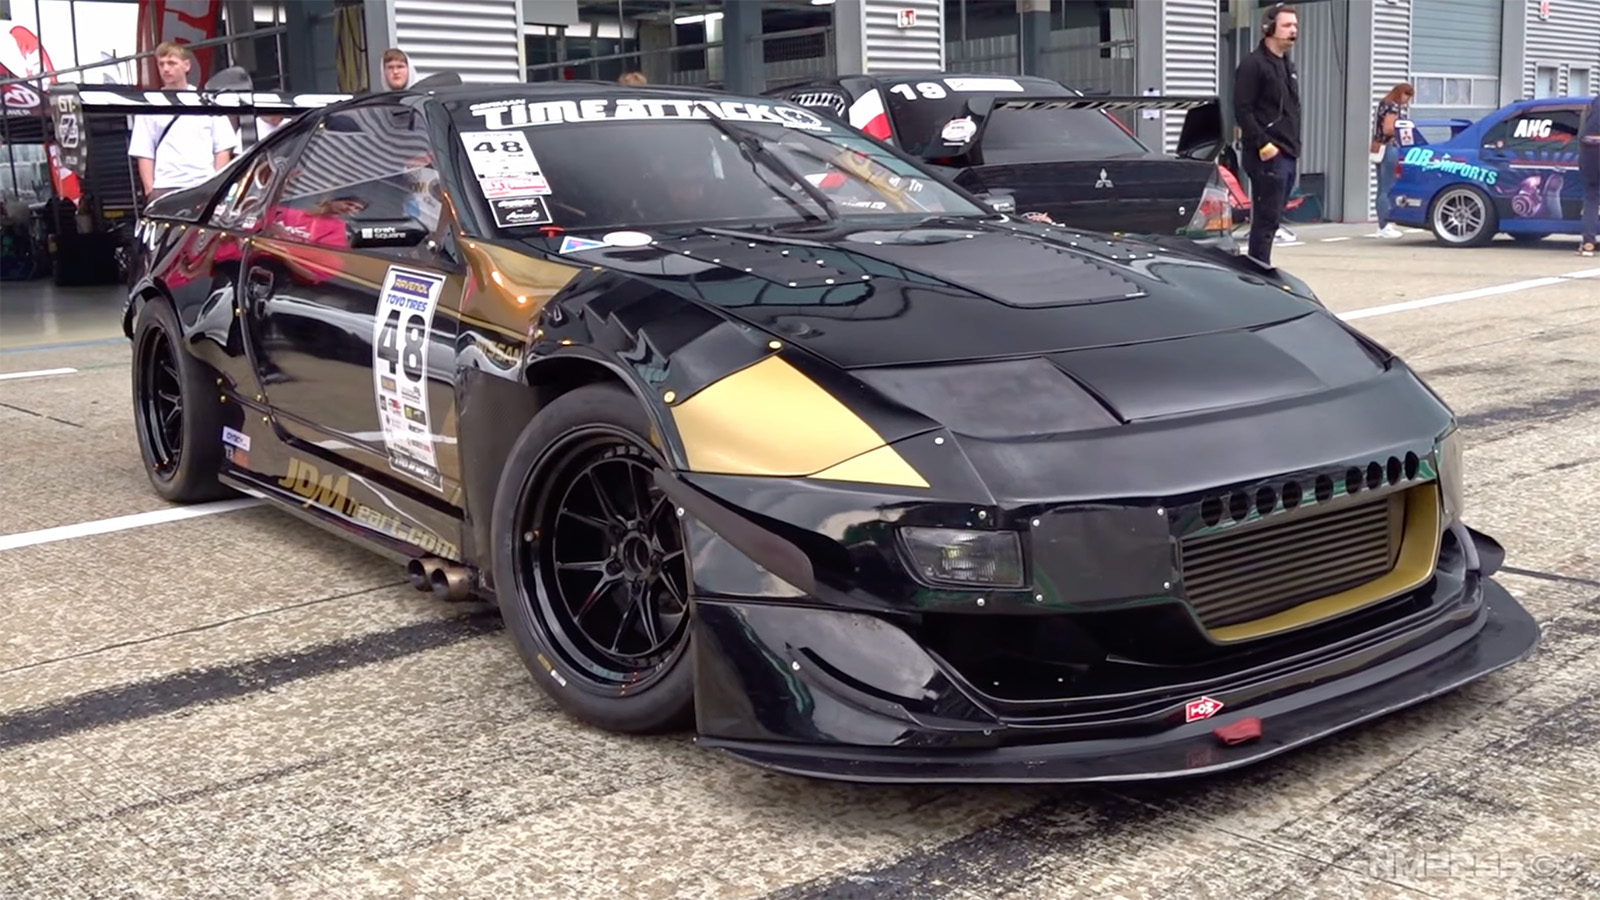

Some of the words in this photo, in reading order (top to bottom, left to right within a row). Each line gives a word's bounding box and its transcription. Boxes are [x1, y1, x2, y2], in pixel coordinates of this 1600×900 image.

[889, 82, 947, 100] 19
[1513, 119, 1553, 138] AHG
[473, 141, 524, 153] 48
[374, 232, 407, 240] square
[395, 278, 428, 294] RAVENOL
[386, 293, 406, 307] TOYO
[406, 298, 428, 312] TIRES
[377, 310, 426, 382] 48
